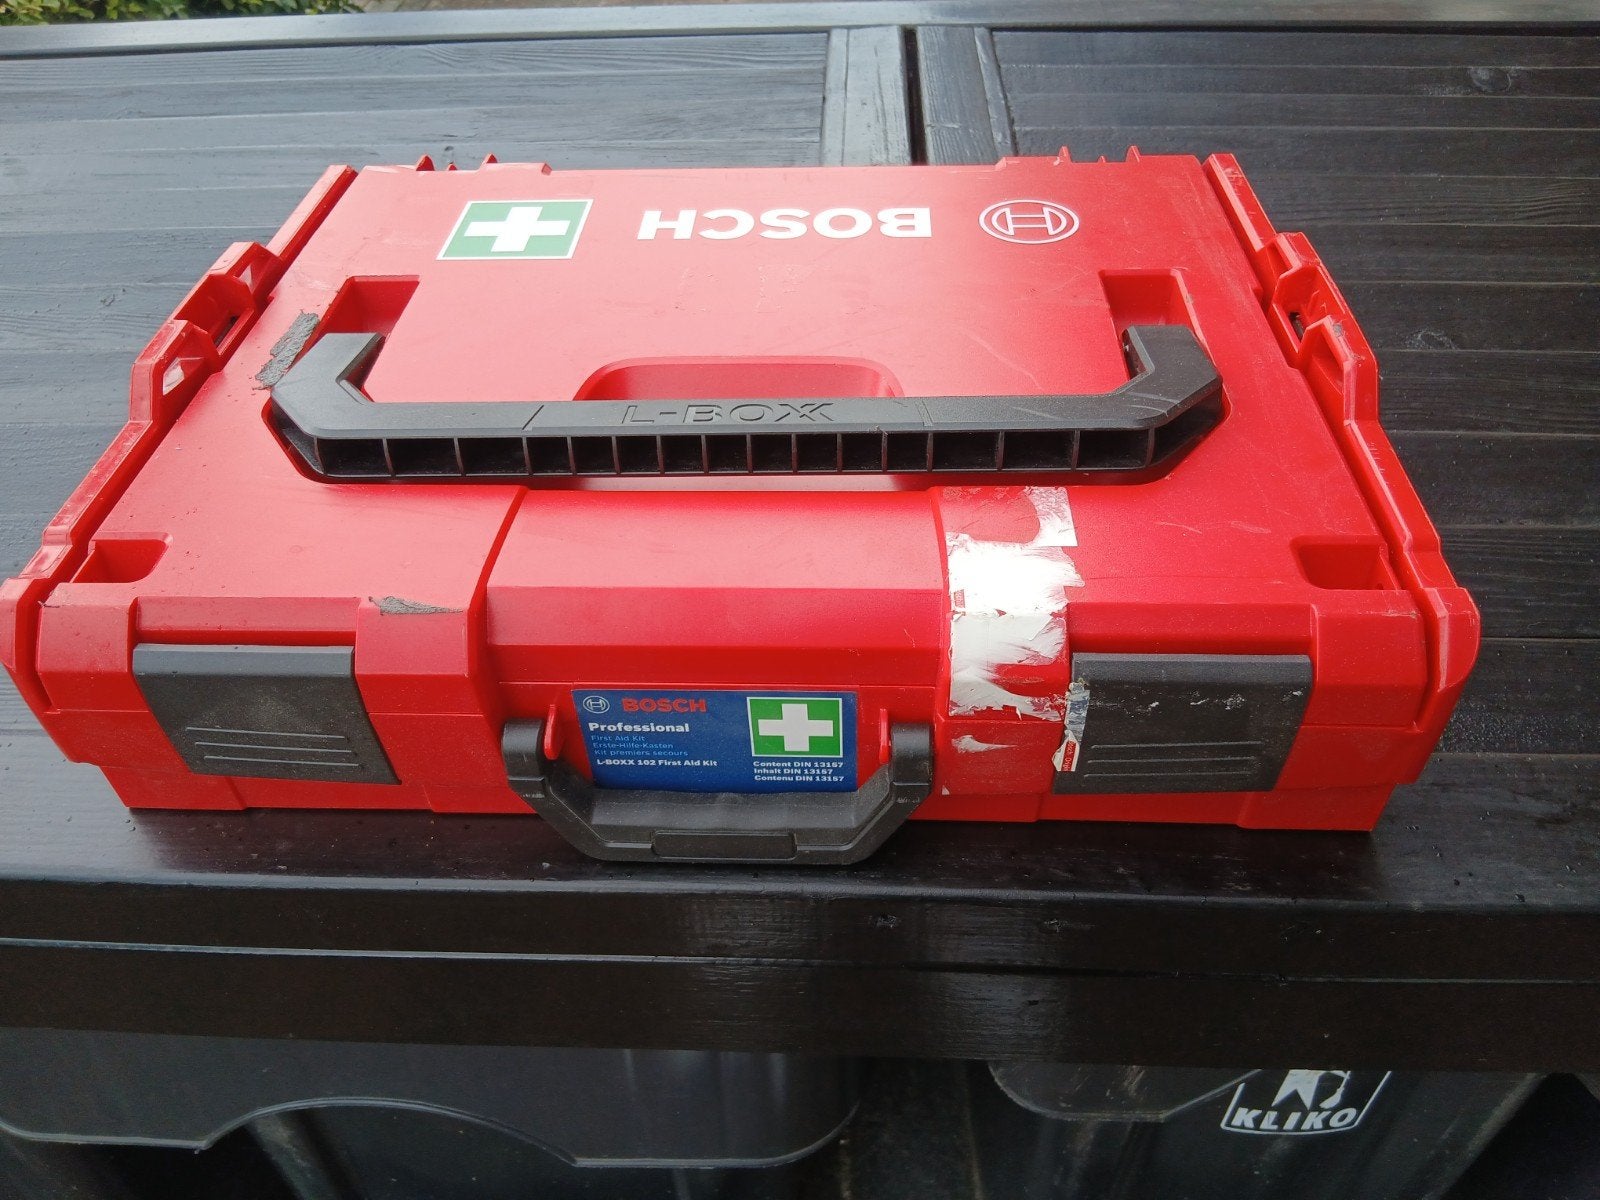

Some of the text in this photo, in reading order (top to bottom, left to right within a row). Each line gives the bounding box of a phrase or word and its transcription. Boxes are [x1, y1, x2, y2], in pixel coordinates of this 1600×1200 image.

[636, 207, 933, 240] BOSCH
[622, 698, 706, 712] BOSCH
[588, 722, 690, 733] Professional
[610, 750, 650, 758] premiers
[596, 758, 636, 766] L-BOXX
[658, 759, 682, 767] First
[684, 759, 701, 767] Aid
[703, 759, 718, 767] Kit
[1231, 1107, 1357, 1130] KLIKO
